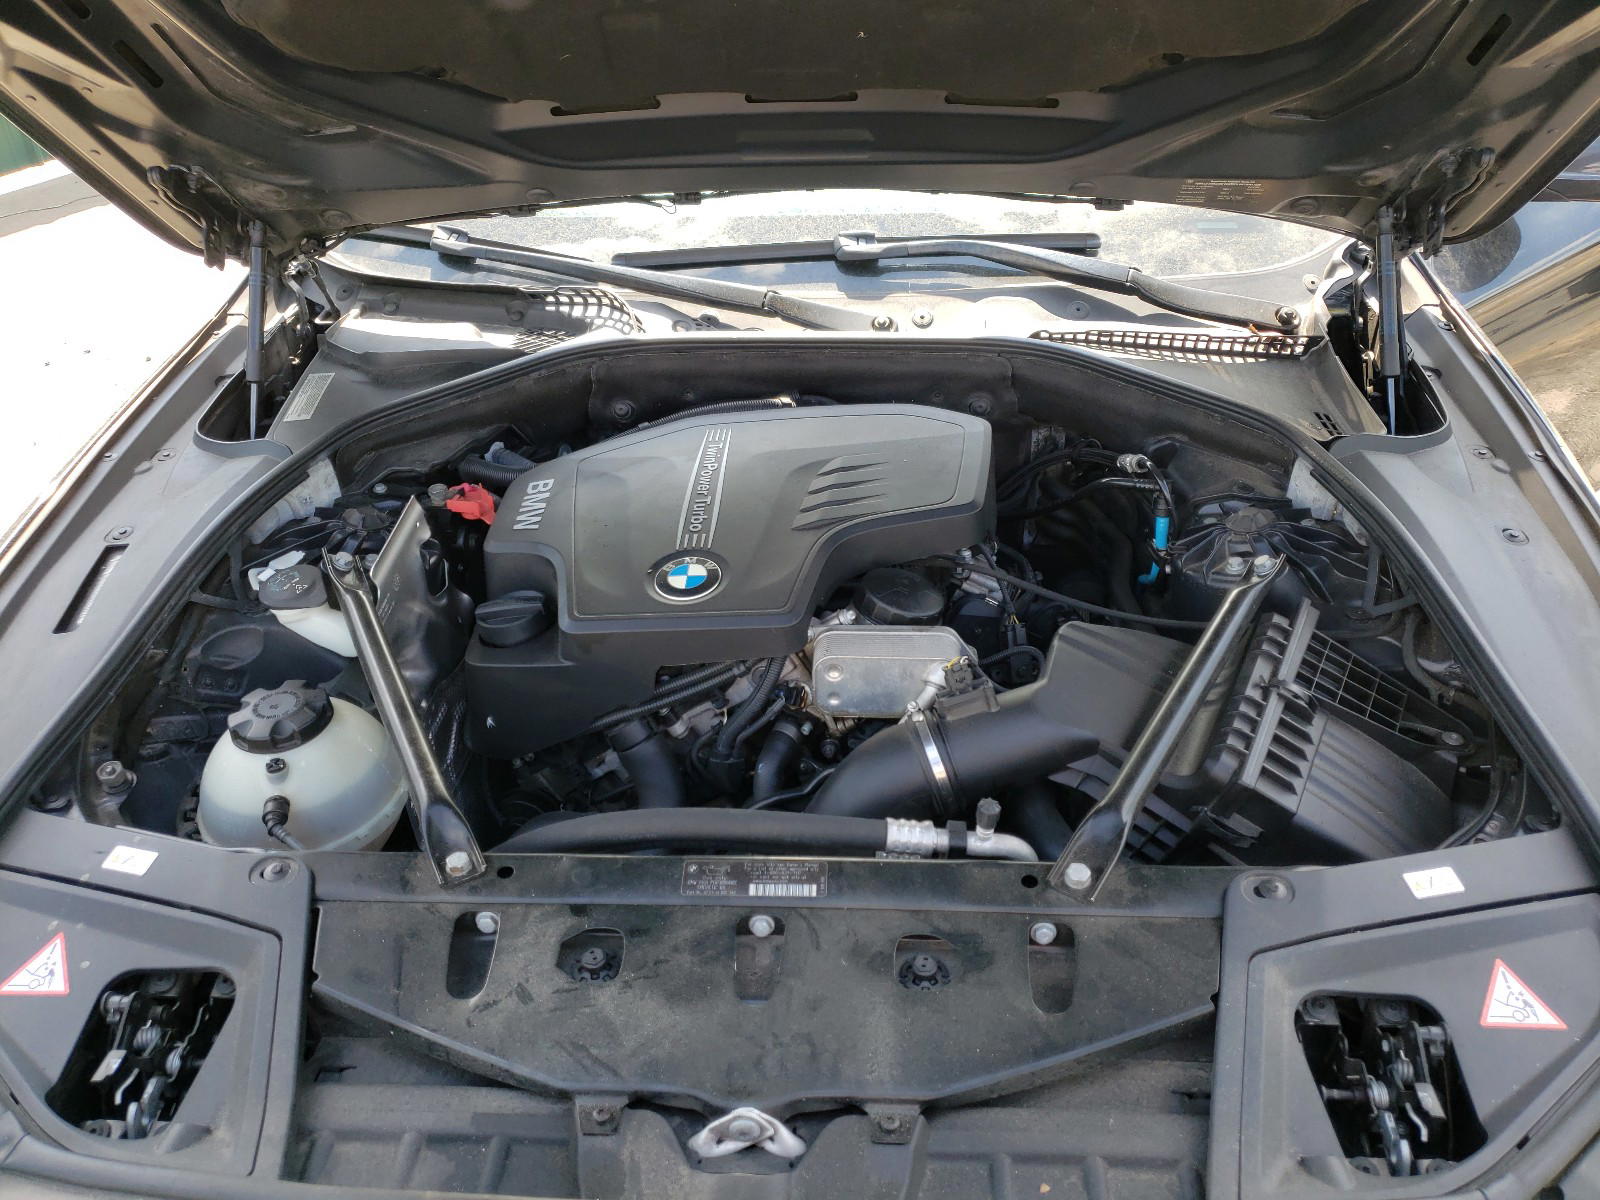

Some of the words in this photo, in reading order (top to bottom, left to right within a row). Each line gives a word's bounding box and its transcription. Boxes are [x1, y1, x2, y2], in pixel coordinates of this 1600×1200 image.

[697, 442, 724, 496] TwinPower
[512, 478, 555, 530] BMW
[689, 496, 711, 532] Turbo
